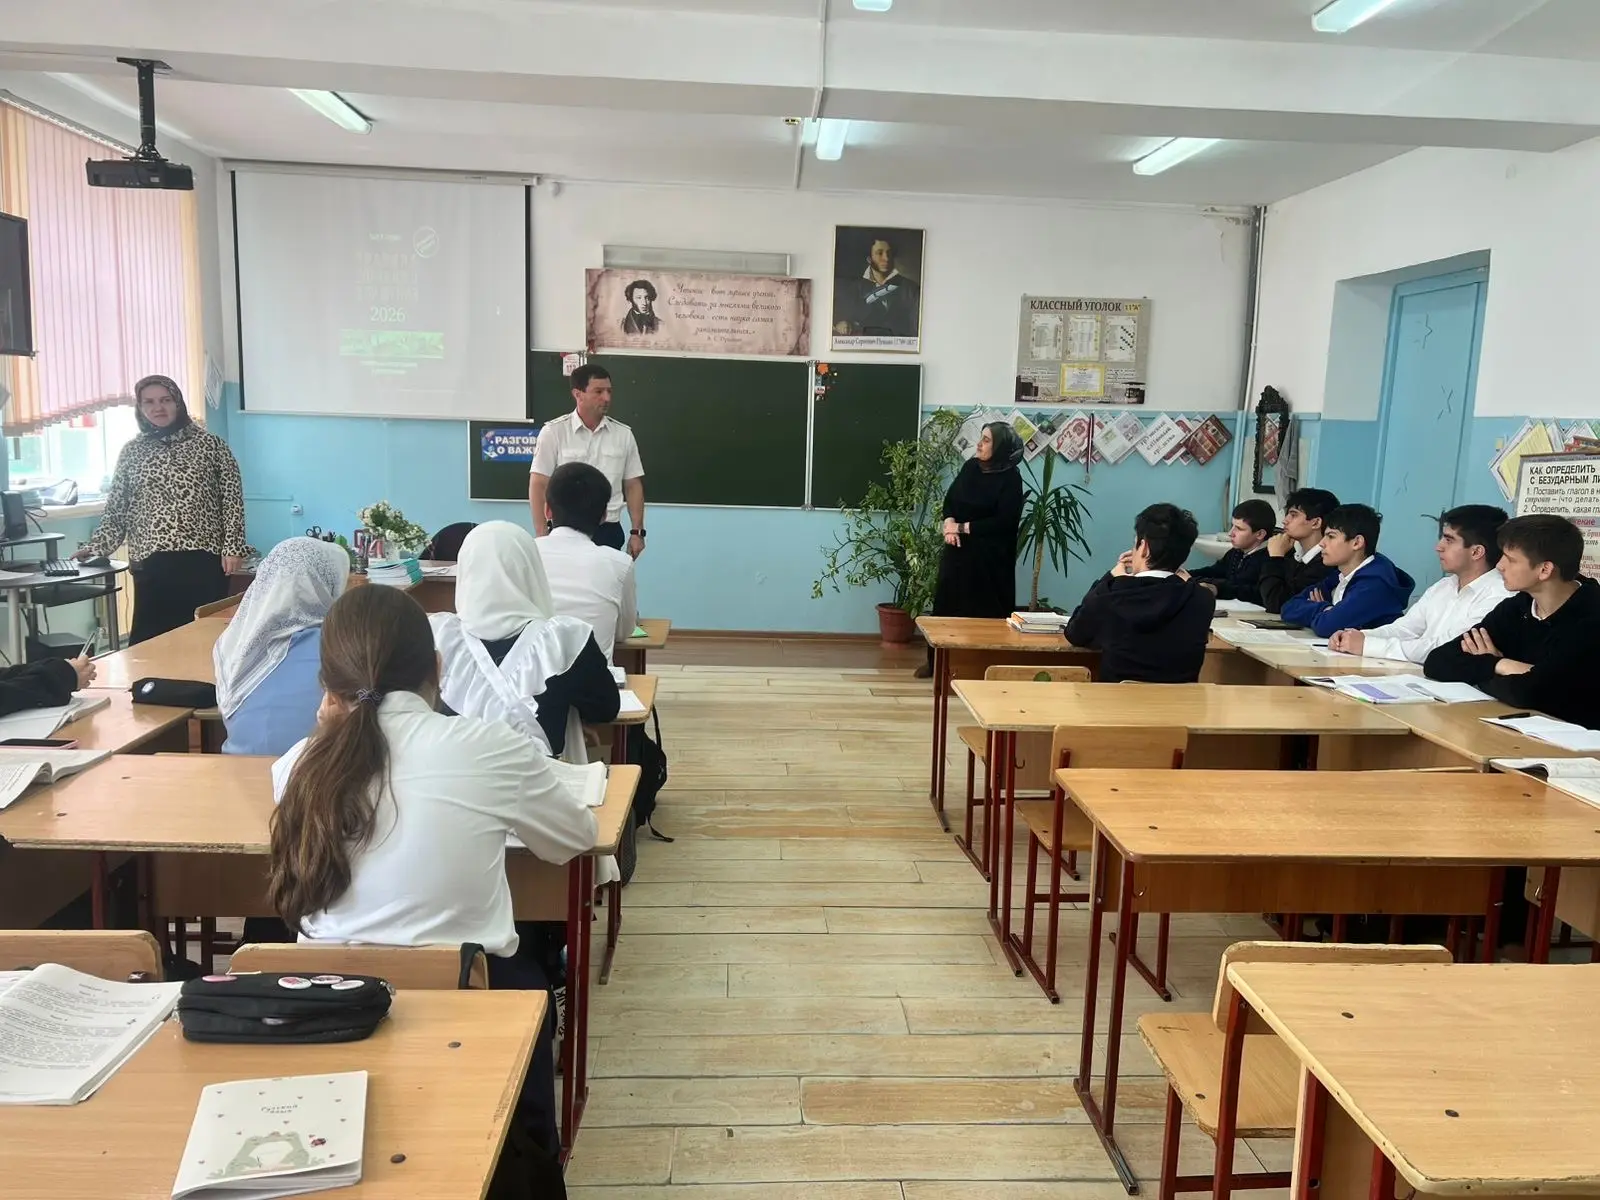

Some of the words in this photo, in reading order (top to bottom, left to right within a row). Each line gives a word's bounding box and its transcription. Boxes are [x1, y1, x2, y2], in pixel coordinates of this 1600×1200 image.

[1030, 299, 1083, 311] КЛАССНЫЙ
[1084, 301, 1122, 312] УГОЛОК
[371, 306, 405, 322] 2026
[495, 435, 538, 445] РАЗГОВ
[496, 446, 506, 454] О
[1530, 466, 1544, 475] КАК
[1545, 465, 1596, 475] ОПРЕДЕЛИТЬ
[1530, 476, 1535, 485] С
[1538, 475, 1589, 485] БЕЗУДАРНЫМ
[1534, 487, 1565, 495] Поставить
